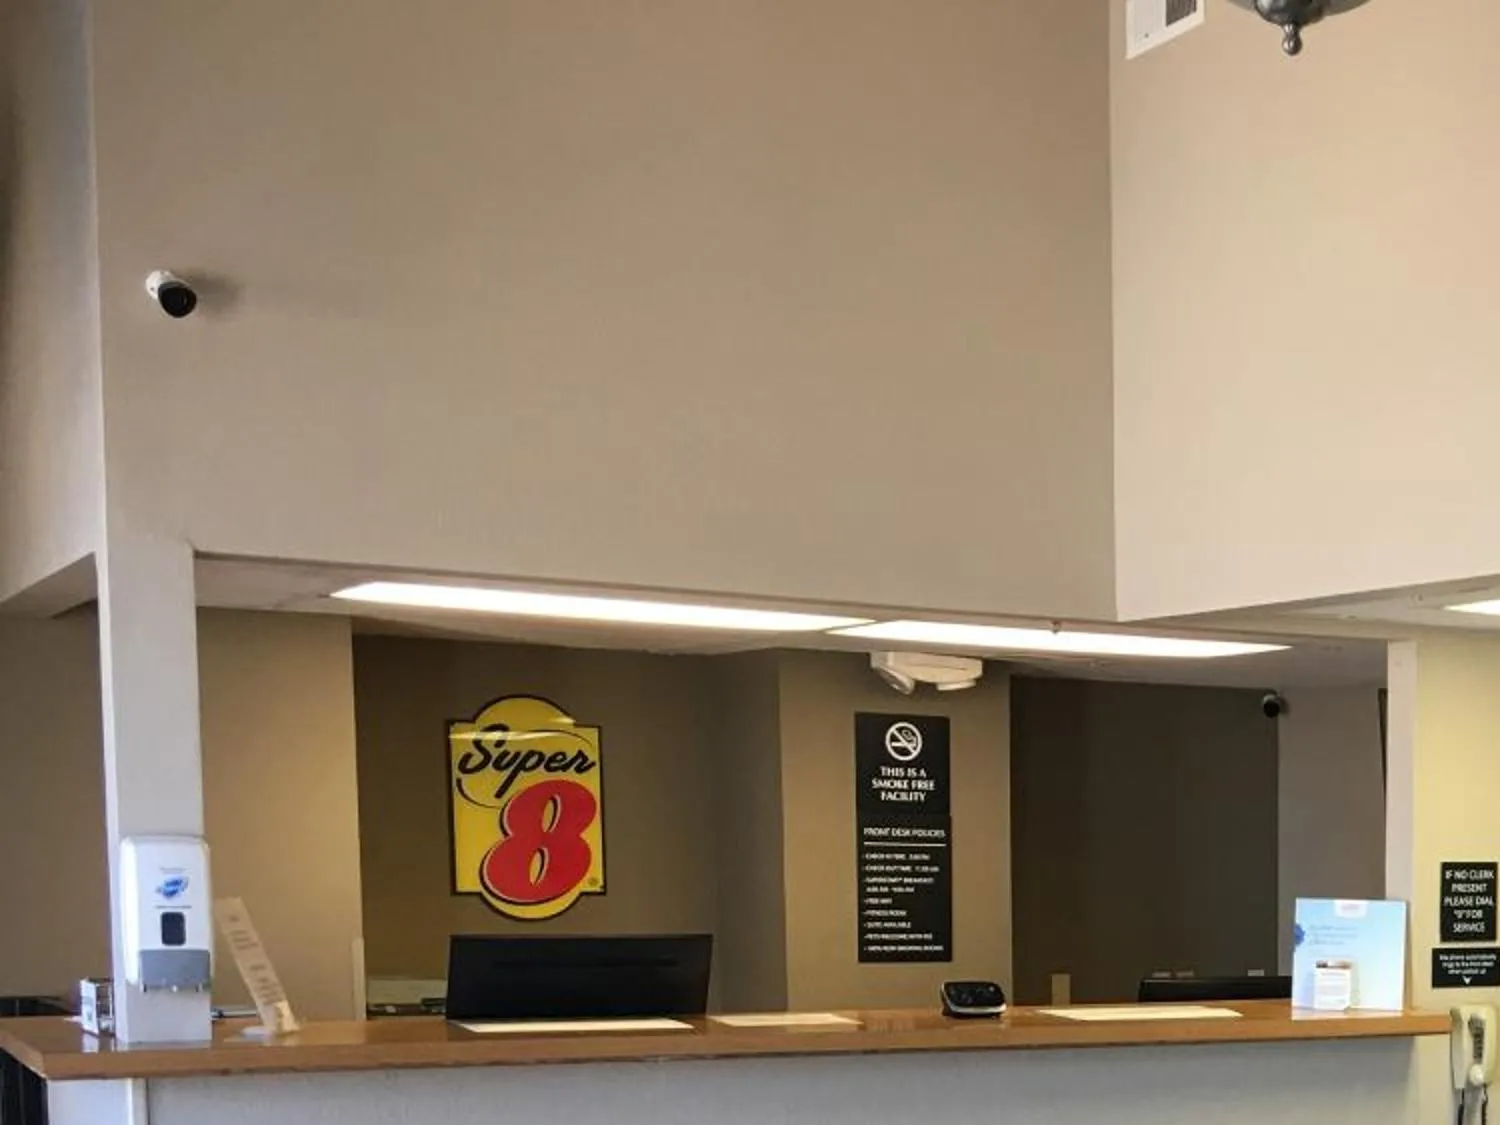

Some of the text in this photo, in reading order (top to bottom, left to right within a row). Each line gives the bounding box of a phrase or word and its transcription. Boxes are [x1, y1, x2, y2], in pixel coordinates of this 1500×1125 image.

[458, 723, 597, 799] Super
[880, 766, 927, 778] THIS IS A
[871, 778, 936, 791] SMOKE FREE
[880, 791, 926, 802] FACILITY
[863, 827, 946, 838] FRONT DESK POLICIES
[479, 779, 598, 906] 8
[1445, 869, 1495, 880] IF NO CLERK
[1451, 883, 1487, 893] PRESENT
[1444, 896, 1494, 907] PLEASE DIAL
[1465, 909, 1483, 919] FOR
[1452, 922, 1486, 933] SERVICE
